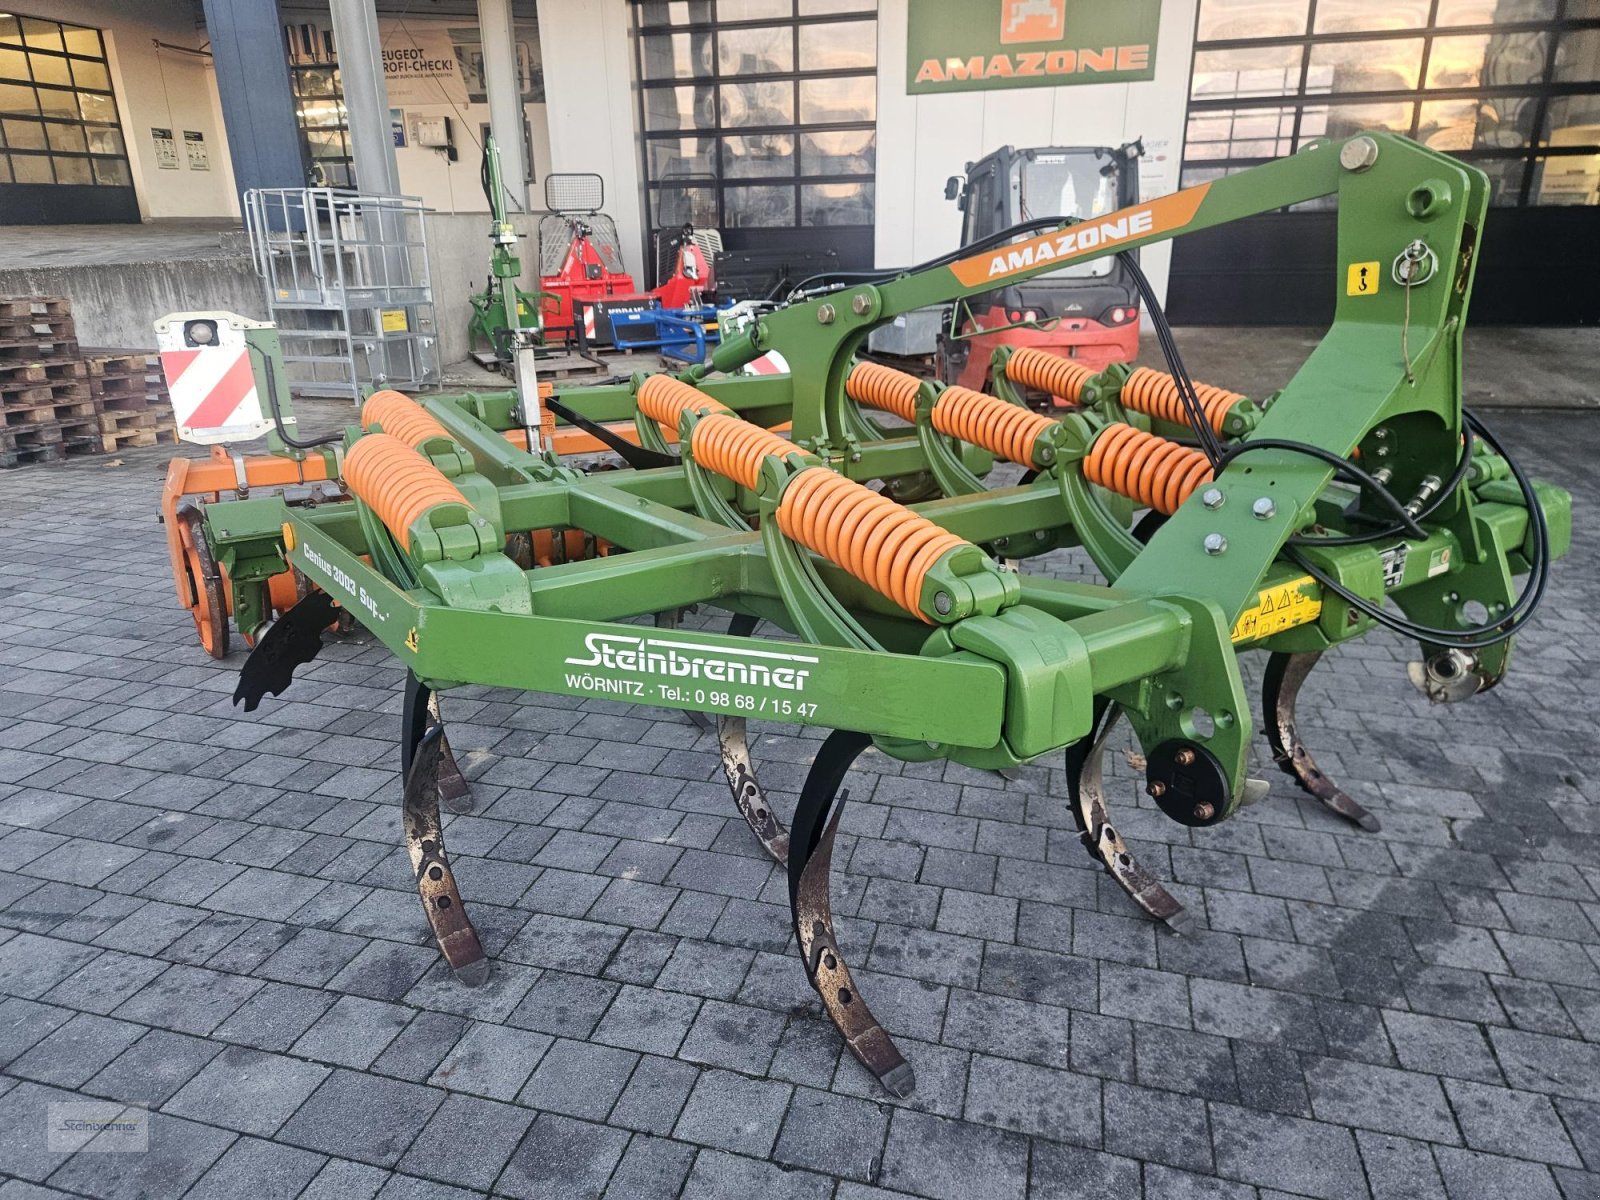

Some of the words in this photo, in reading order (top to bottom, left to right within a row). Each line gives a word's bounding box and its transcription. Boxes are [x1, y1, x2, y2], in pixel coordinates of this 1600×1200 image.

[381, 49, 424, 60] EUGEOT
[383, 60, 453, 72] ROFI-CHECK!
[915, 45, 1149, 83] AMAZONE
[989, 210, 1152, 276] AMAZONE
[333, 565, 356, 597] 3003
[564, 633, 818, 691] Steinbrenner
[564, 673, 645, 697] WÖRNITZ
[658, 685, 690, 702] Tel.:
[695, 690, 705, 704] 0
[710, 692, 730, 707] 98
[735, 695, 755, 710] 68
[772, 699, 792, 714] 15
[797, 703, 818, 718] 47
